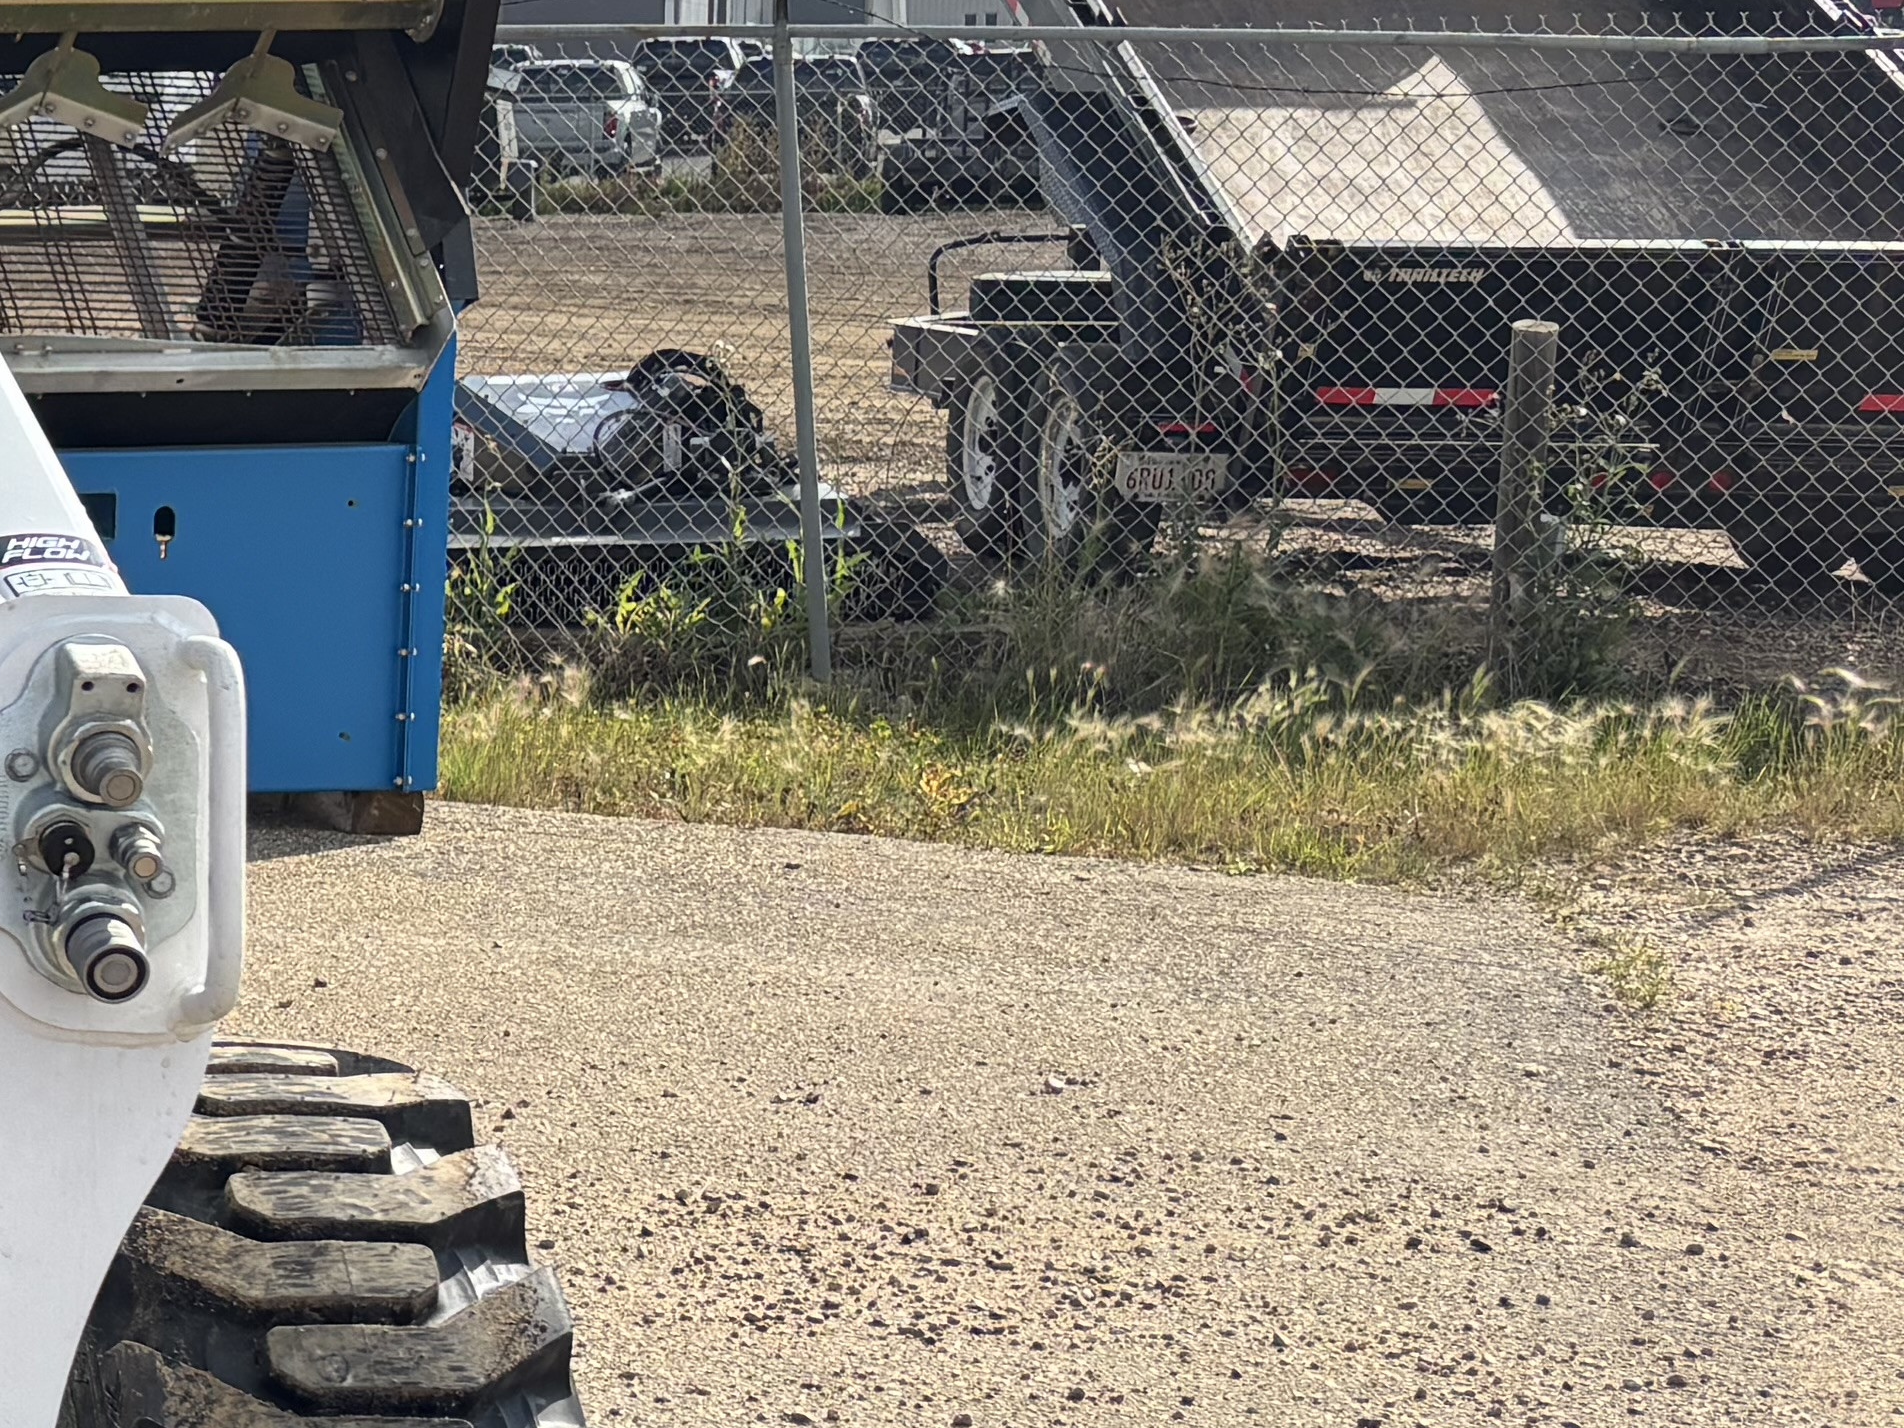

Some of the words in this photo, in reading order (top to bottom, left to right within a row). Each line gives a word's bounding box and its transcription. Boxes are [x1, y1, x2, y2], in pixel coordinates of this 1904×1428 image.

[1387, 267, 1486, 283] TRAILTECH
[6, 536, 81, 551] HIGH
[1, 548, 91, 564] FLOW
